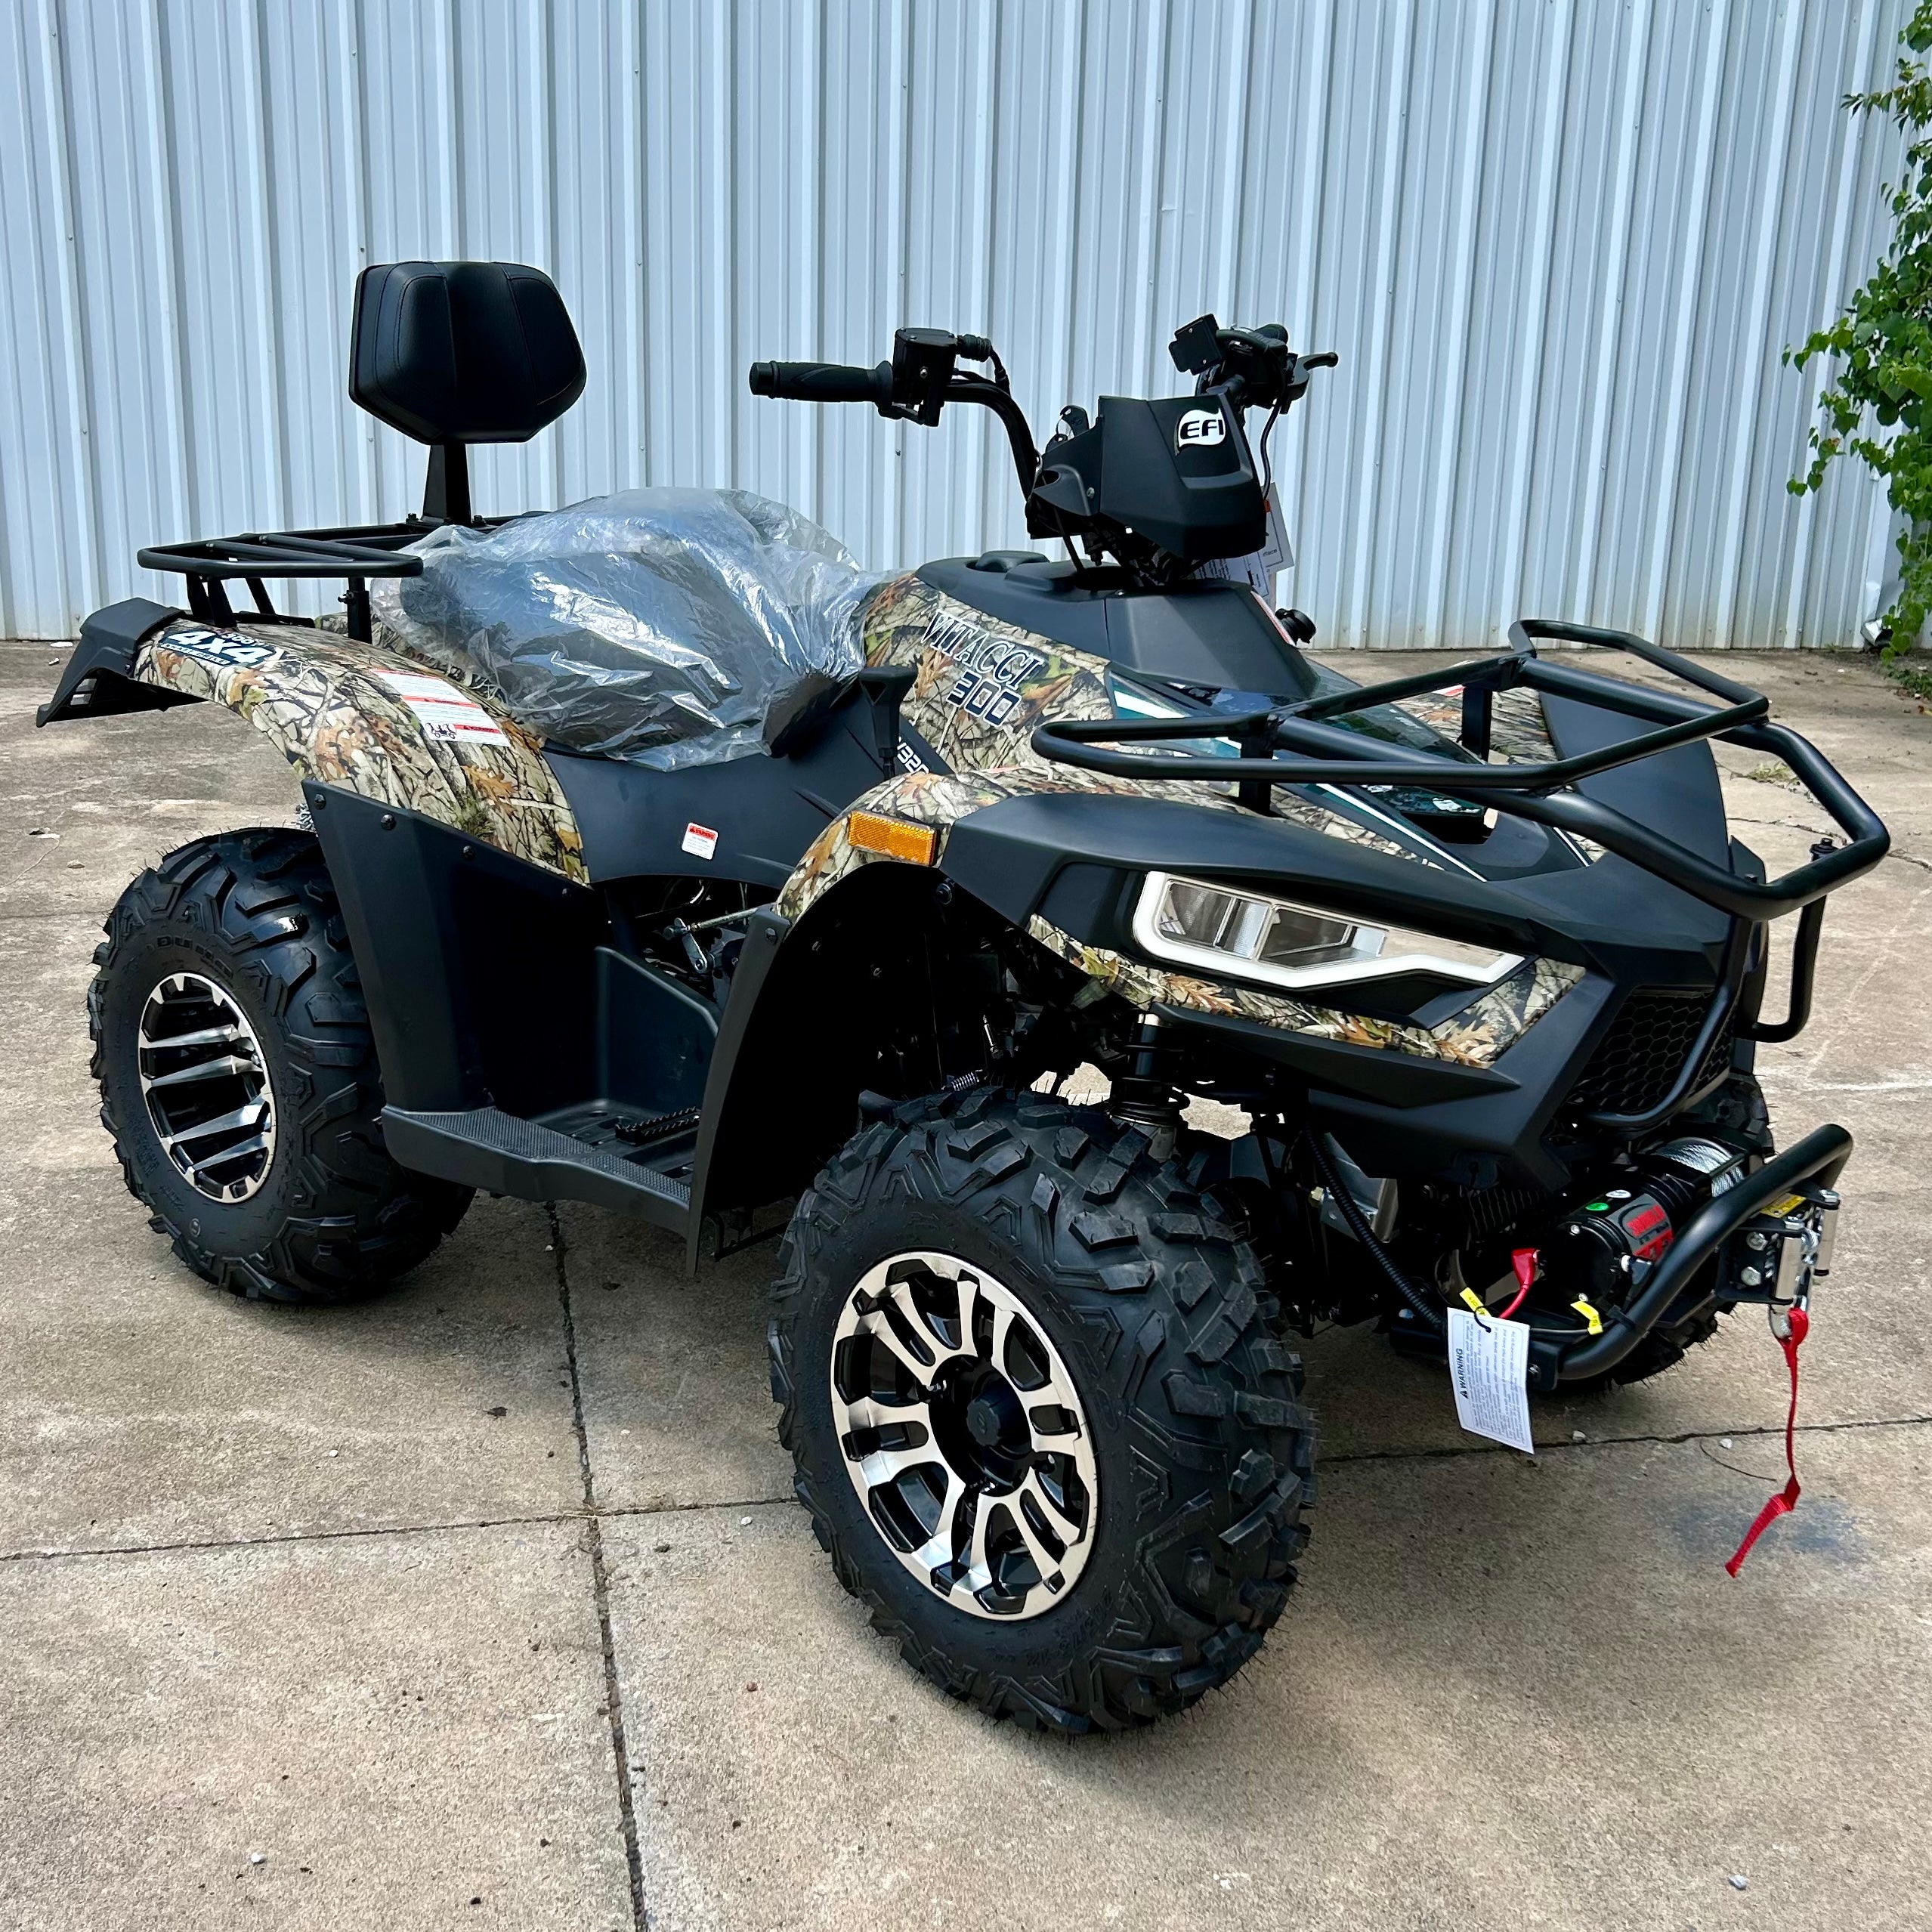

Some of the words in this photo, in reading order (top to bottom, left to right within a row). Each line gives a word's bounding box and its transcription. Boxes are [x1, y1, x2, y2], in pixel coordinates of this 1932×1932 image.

[1180, 419, 1224, 440] EFI
[921, 610, 1044, 691] VITACCI
[946, 669, 1022, 728] 300
[1455, 1348, 1467, 1389] WARNING
